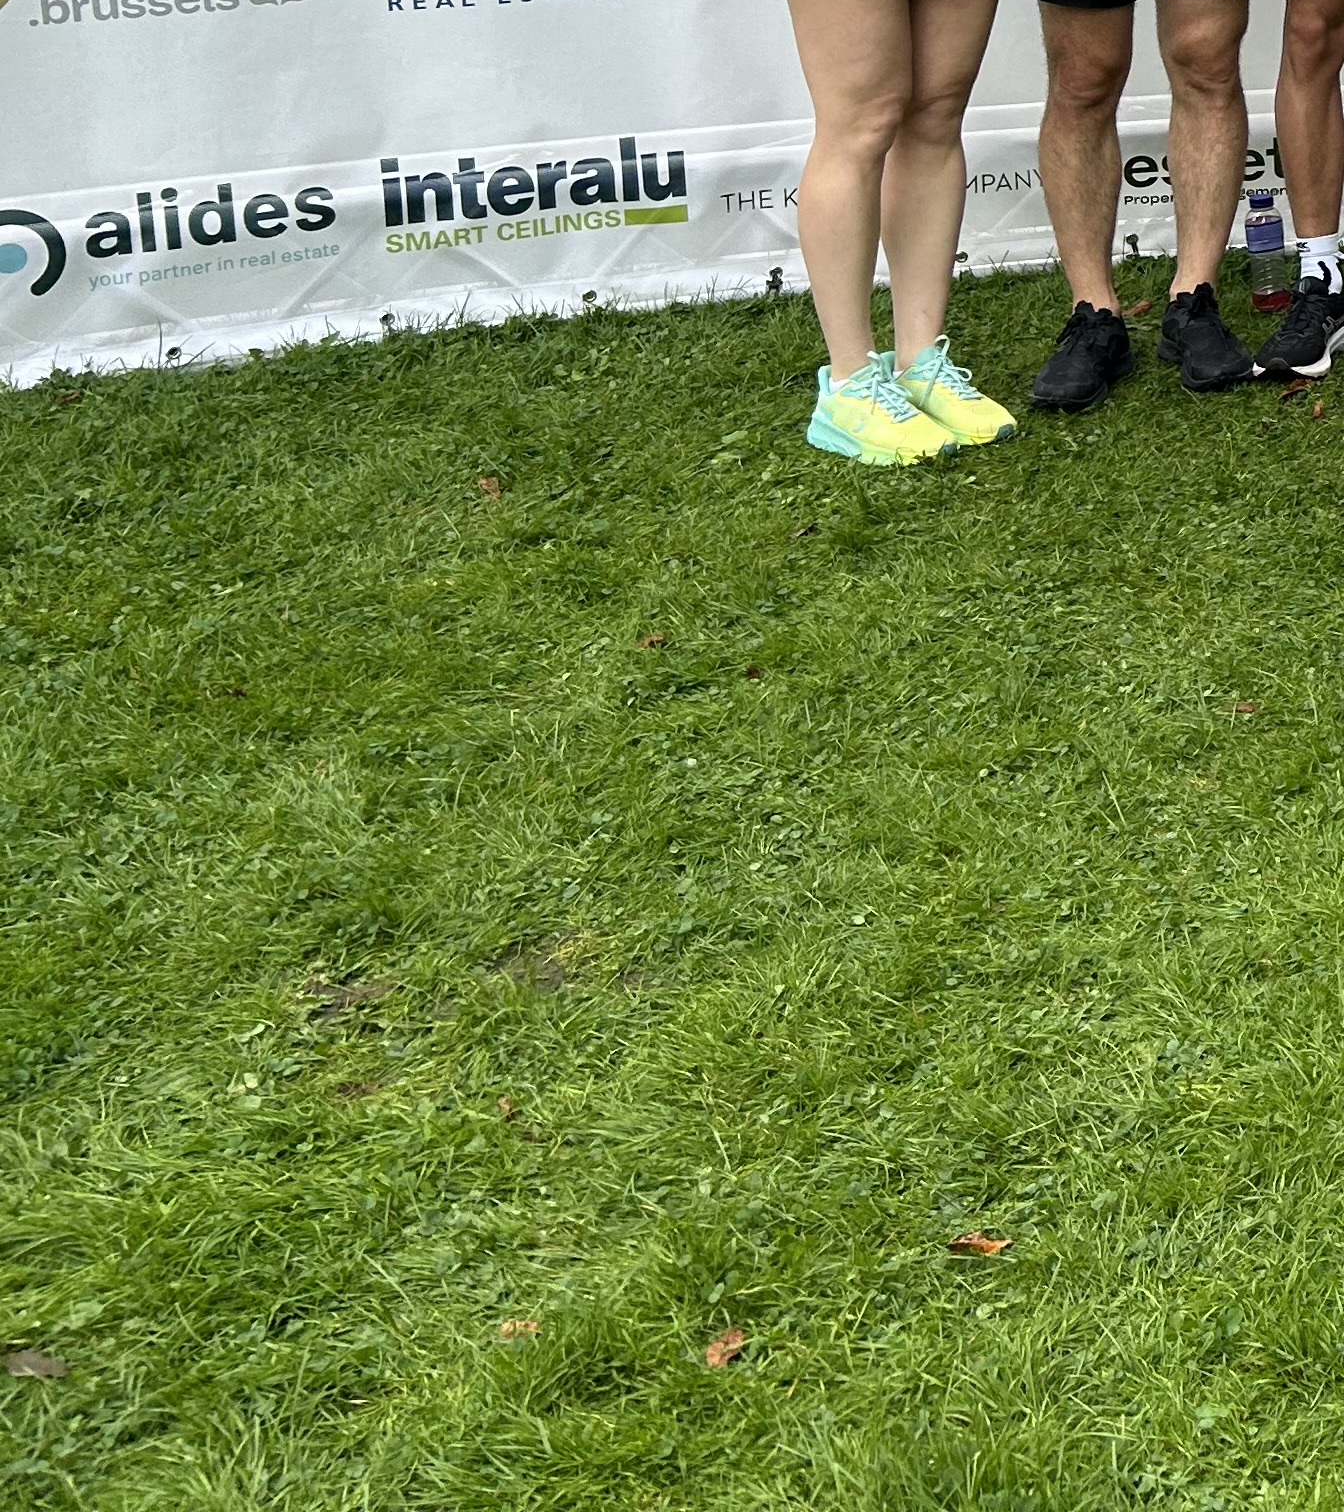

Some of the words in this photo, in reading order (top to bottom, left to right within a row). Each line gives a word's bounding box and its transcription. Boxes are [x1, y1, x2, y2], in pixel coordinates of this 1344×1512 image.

[380, 136, 688, 228] interalu
[720, 190, 773, 214] THE
[84, 183, 337, 259] alides
[385, 225, 485, 254] SMART
[496, 208, 622, 243] CEILINGS
[88, 270, 133, 290] your
[138, 261, 212, 287] partner
[217, 257, 234, 273] in
[239, 251, 276, 271] real
[281, 244, 341, 265] estate
